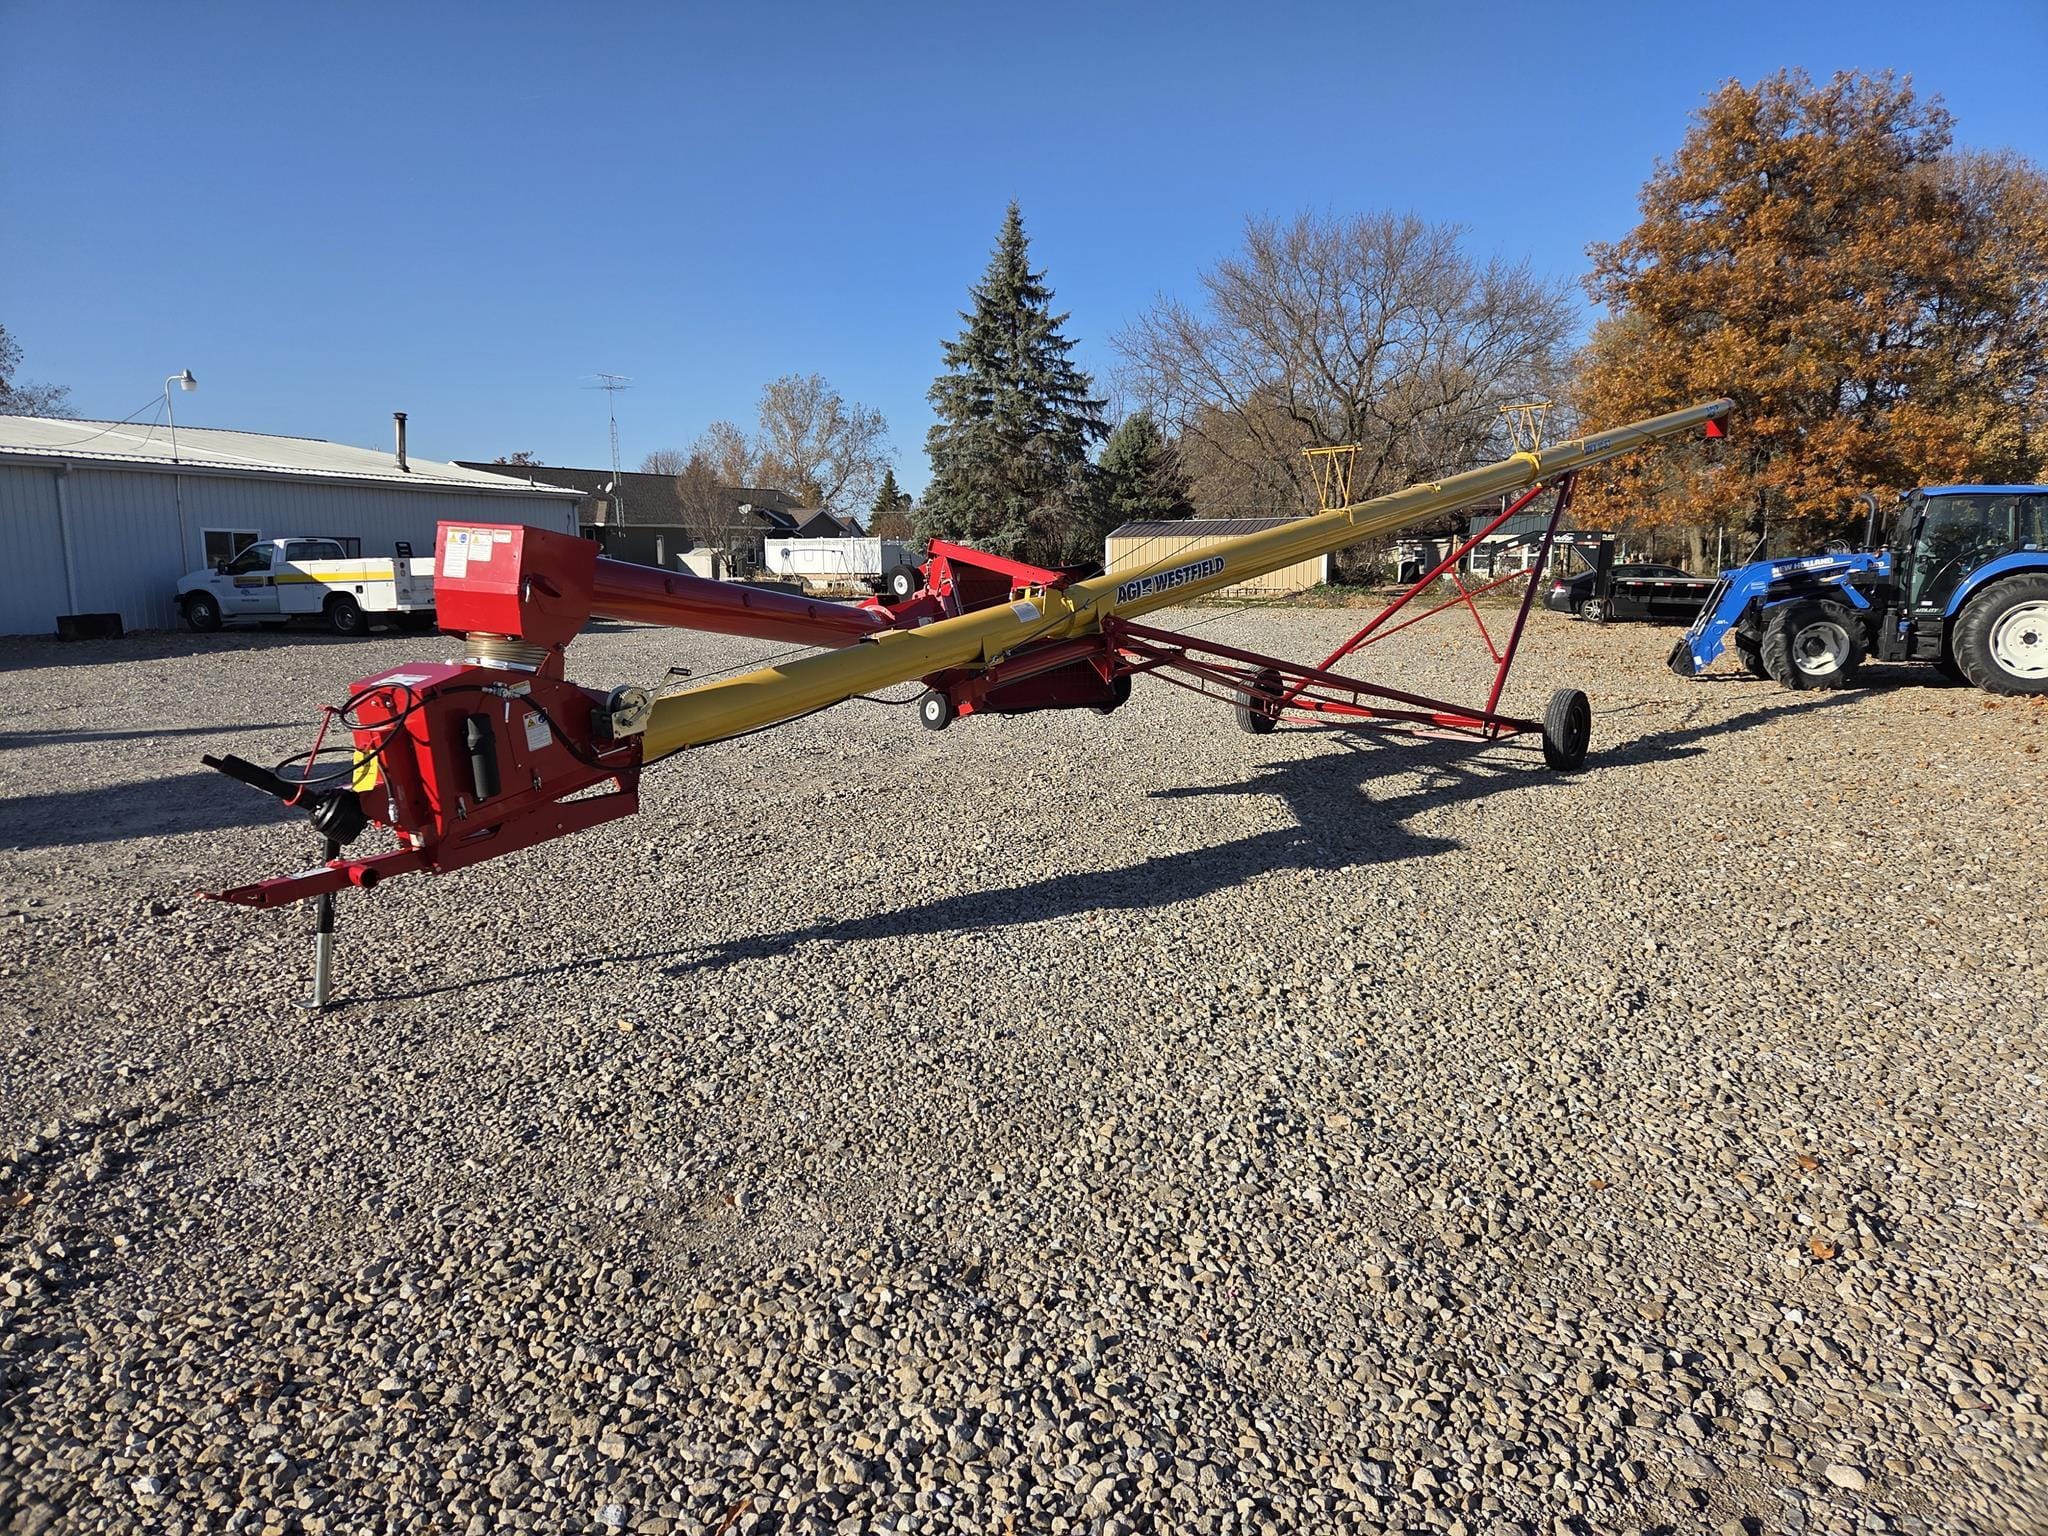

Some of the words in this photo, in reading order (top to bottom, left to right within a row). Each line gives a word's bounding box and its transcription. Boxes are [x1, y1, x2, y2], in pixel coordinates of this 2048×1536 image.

[1794, 558, 1834, 569] HOLLAND
[1116, 581, 1140, 604] AGI
[1154, 557, 1225, 592] WESTFIELD
